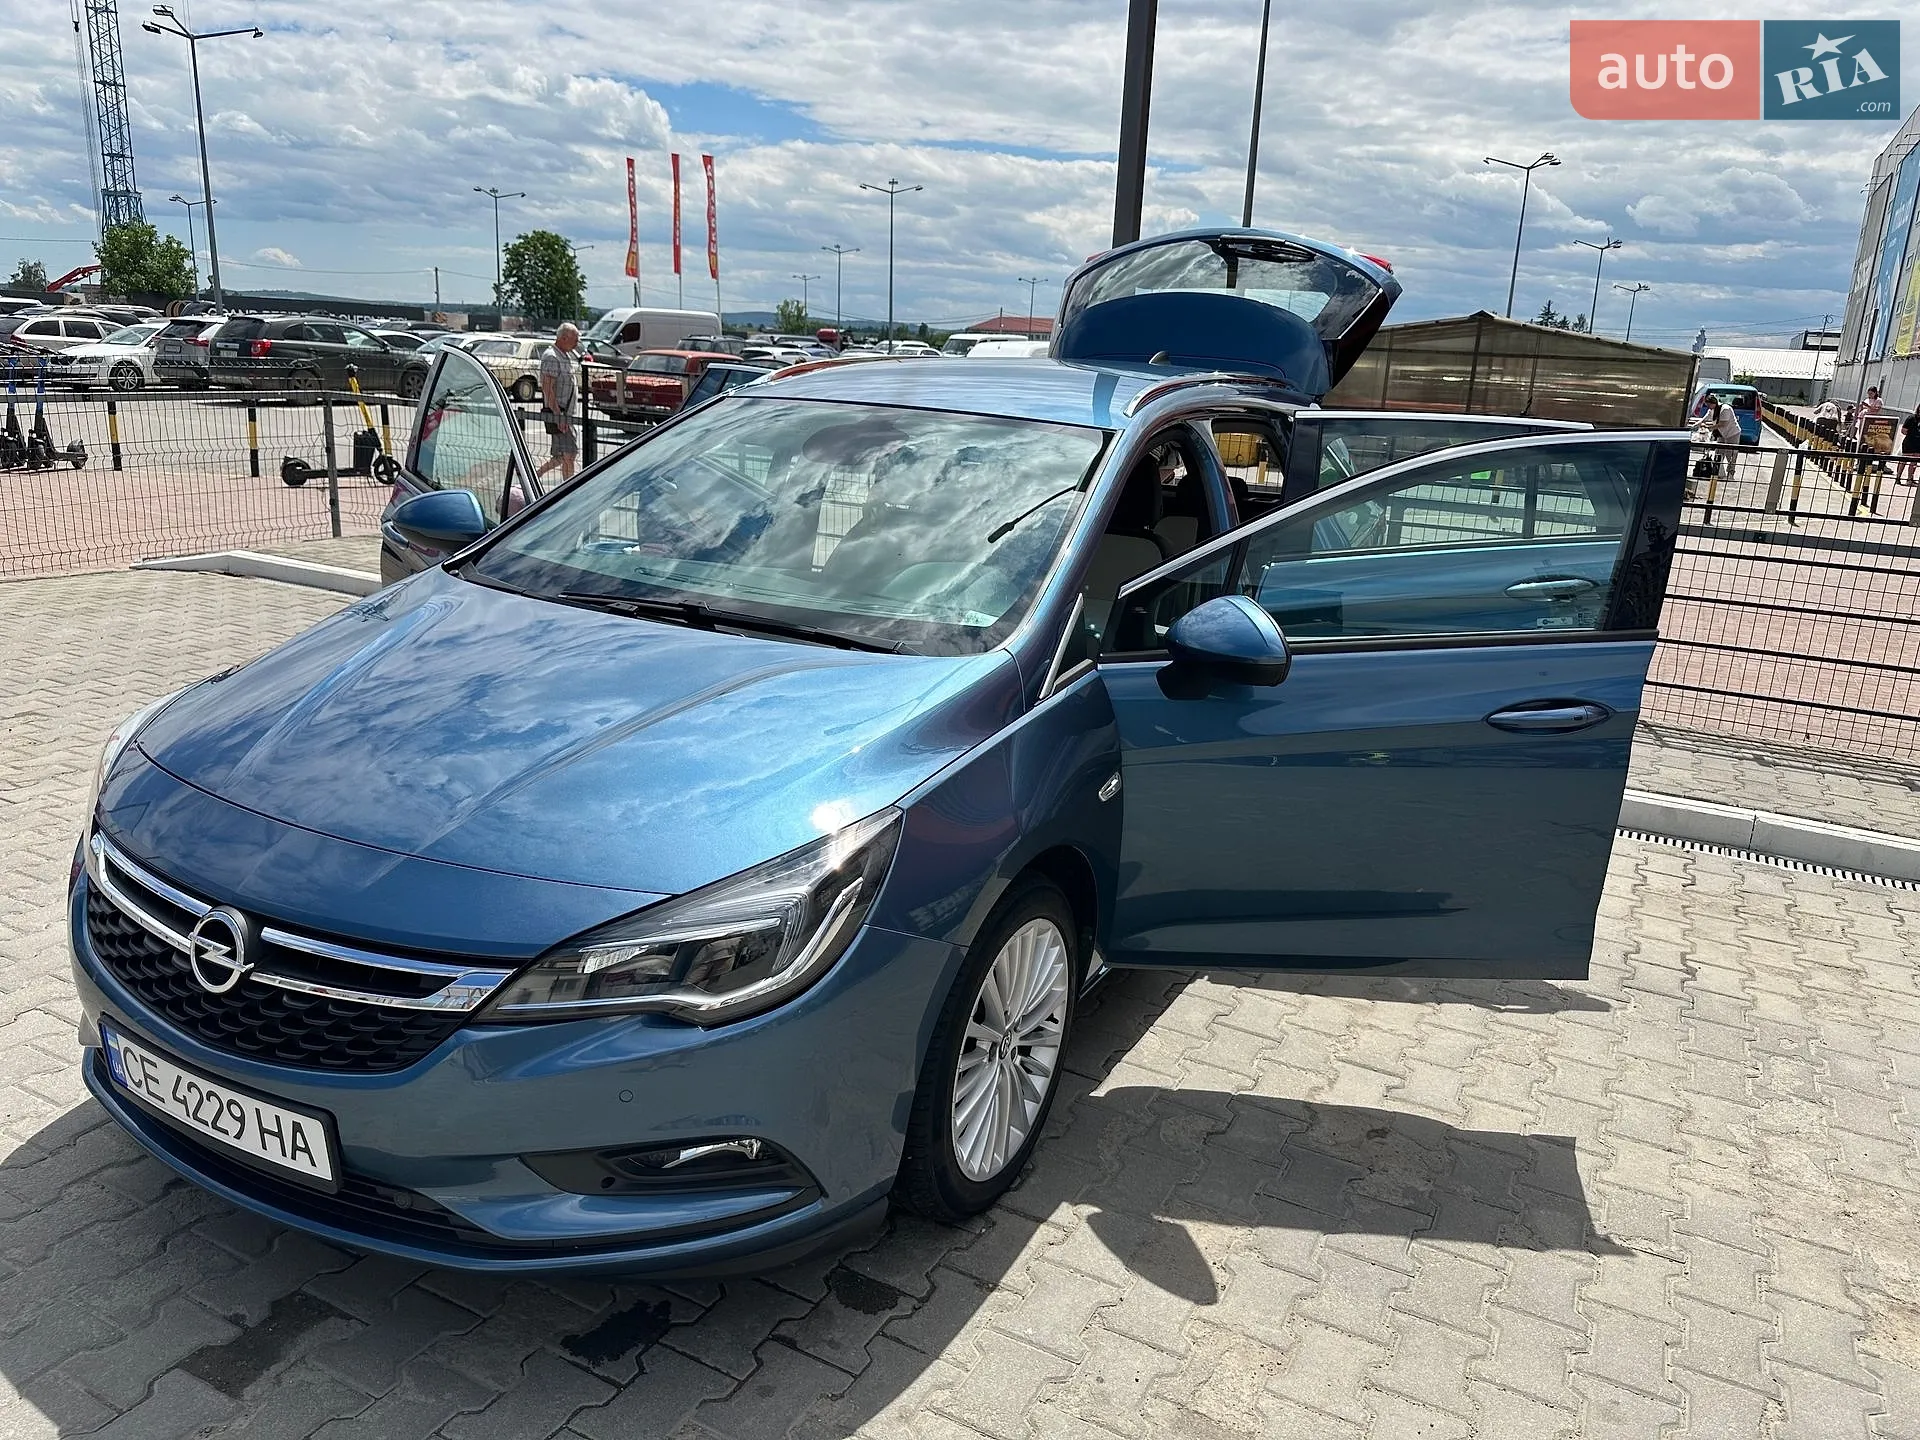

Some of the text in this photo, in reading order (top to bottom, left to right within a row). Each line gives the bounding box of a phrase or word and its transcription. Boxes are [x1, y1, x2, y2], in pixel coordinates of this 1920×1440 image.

[112, 1059, 126, 1078] UA
[122, 1046, 317, 1168] CE 4229 HA
